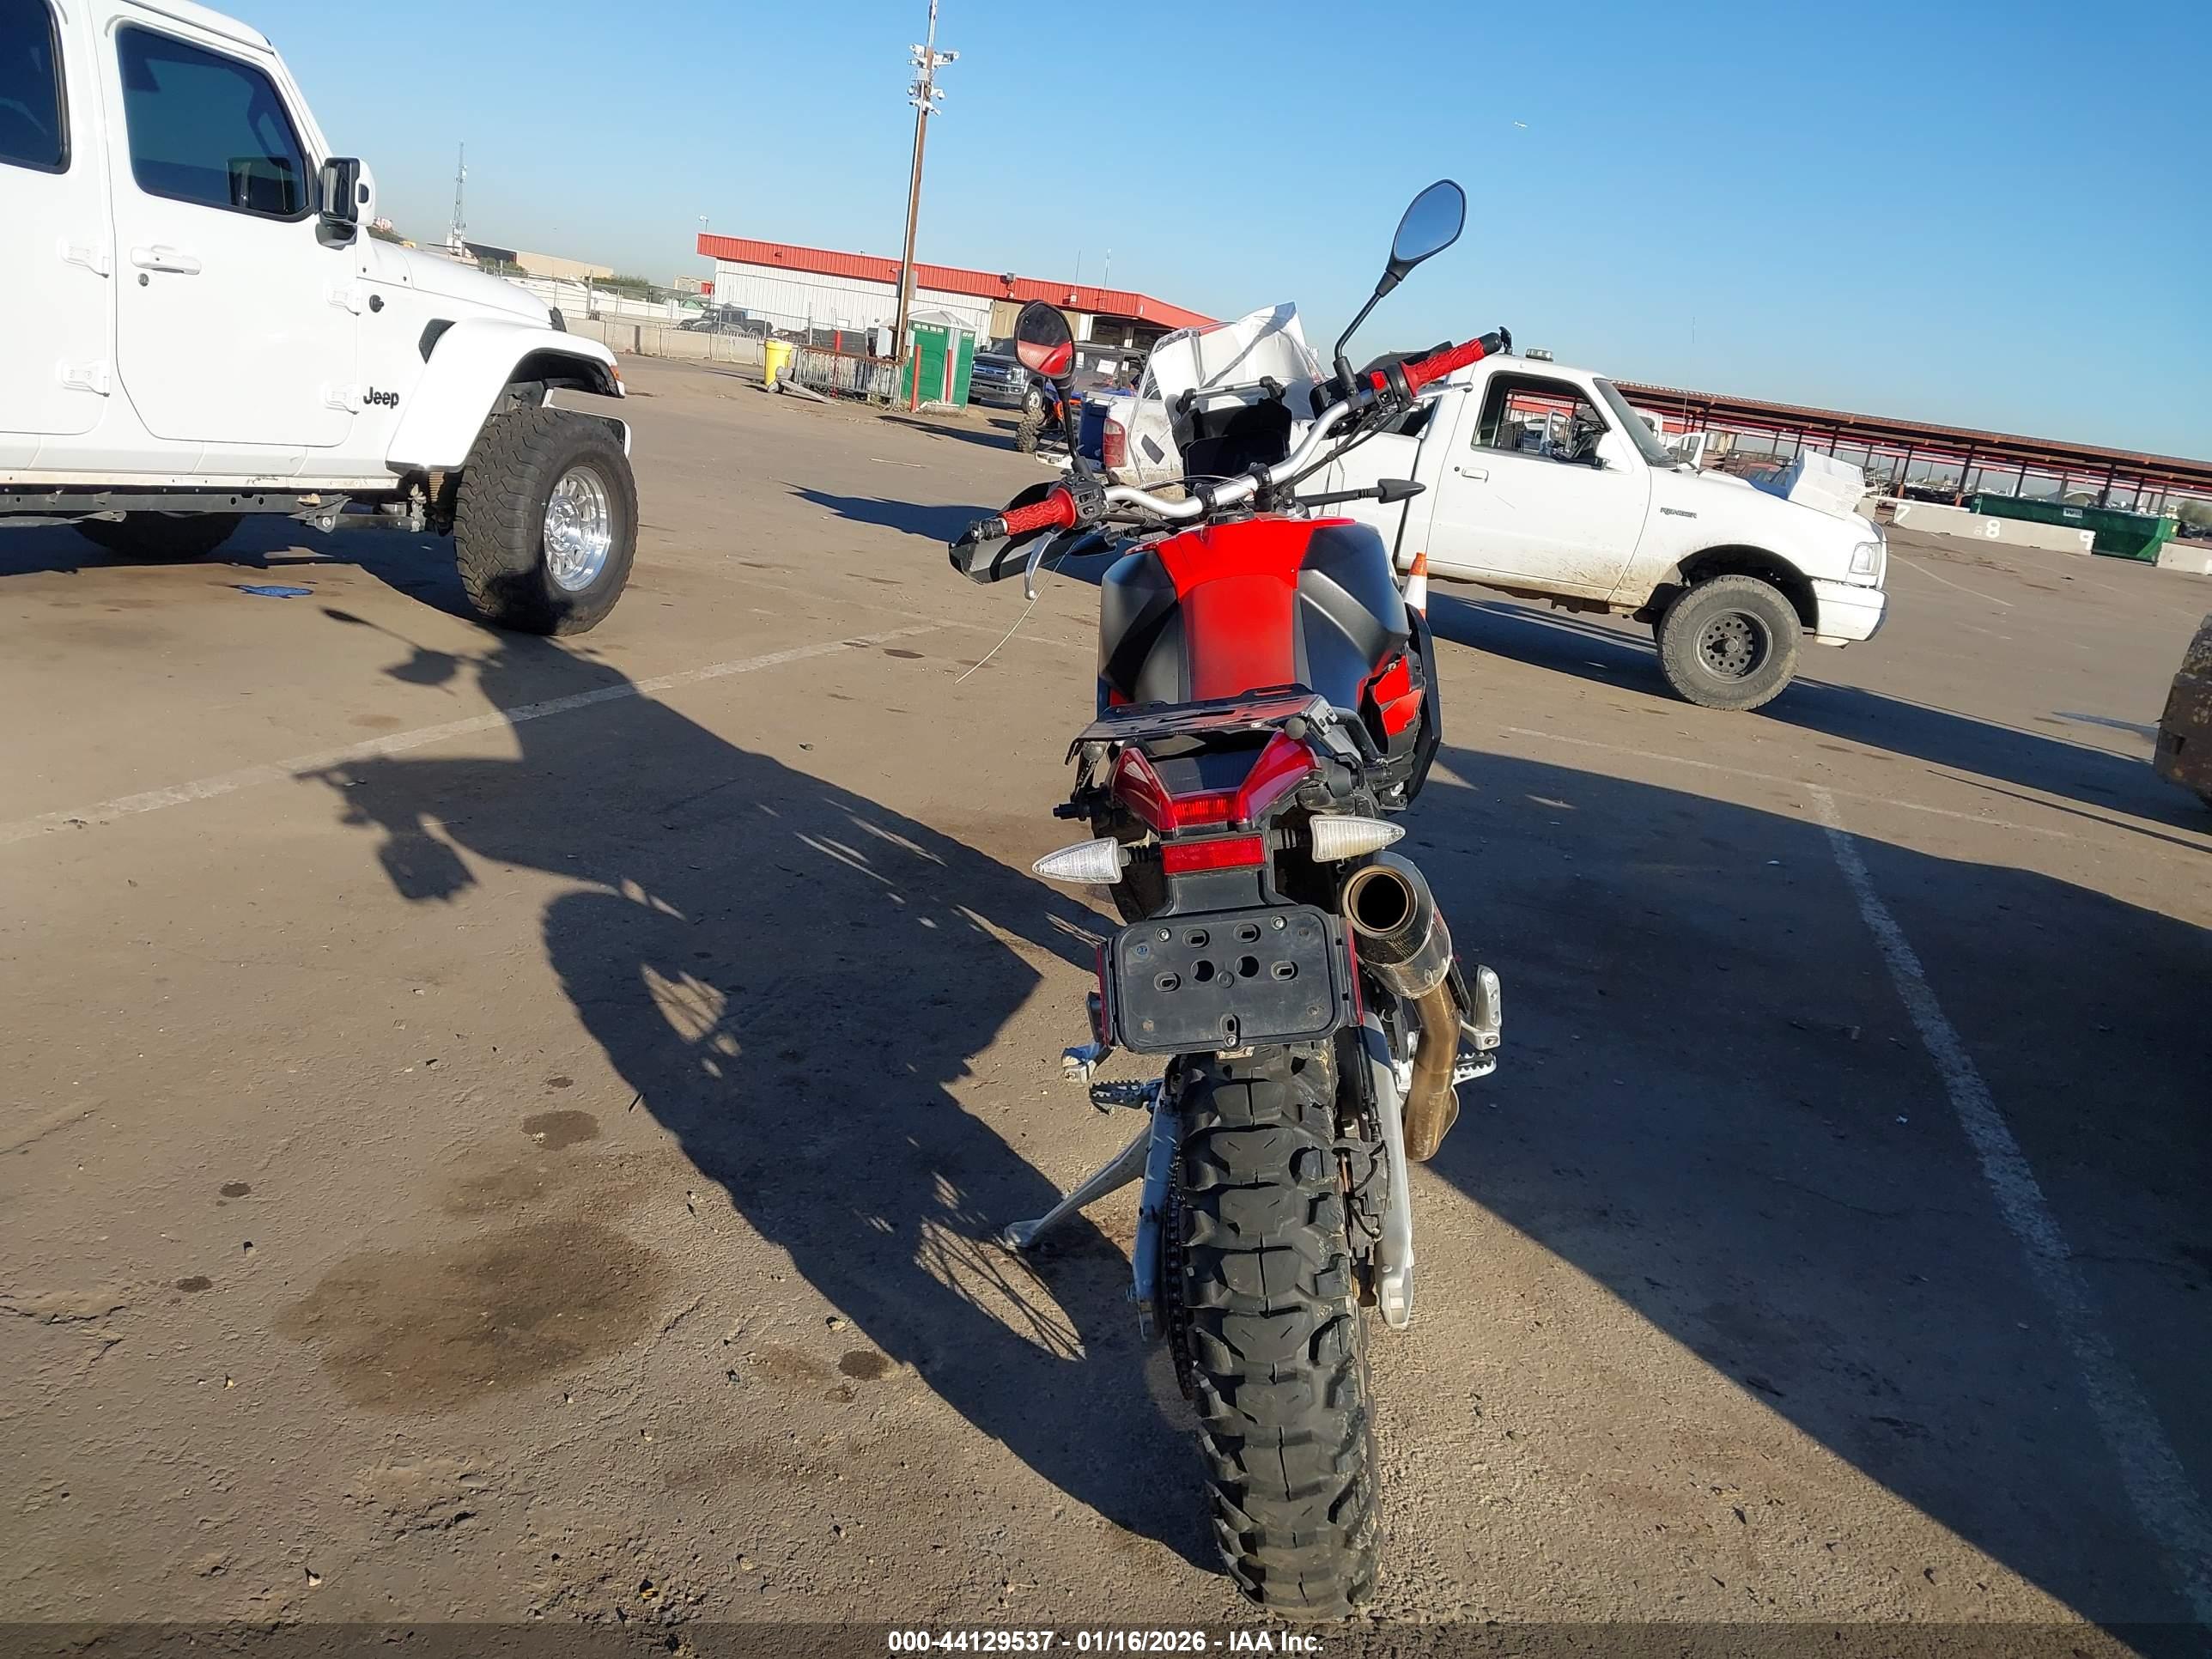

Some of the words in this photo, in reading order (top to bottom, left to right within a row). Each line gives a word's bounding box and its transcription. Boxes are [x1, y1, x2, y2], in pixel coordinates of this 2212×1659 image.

[363, 386, 399, 409] Jeep
[1896, 504, 1911, 522] 7
[1985, 520, 2001, 538] 8
